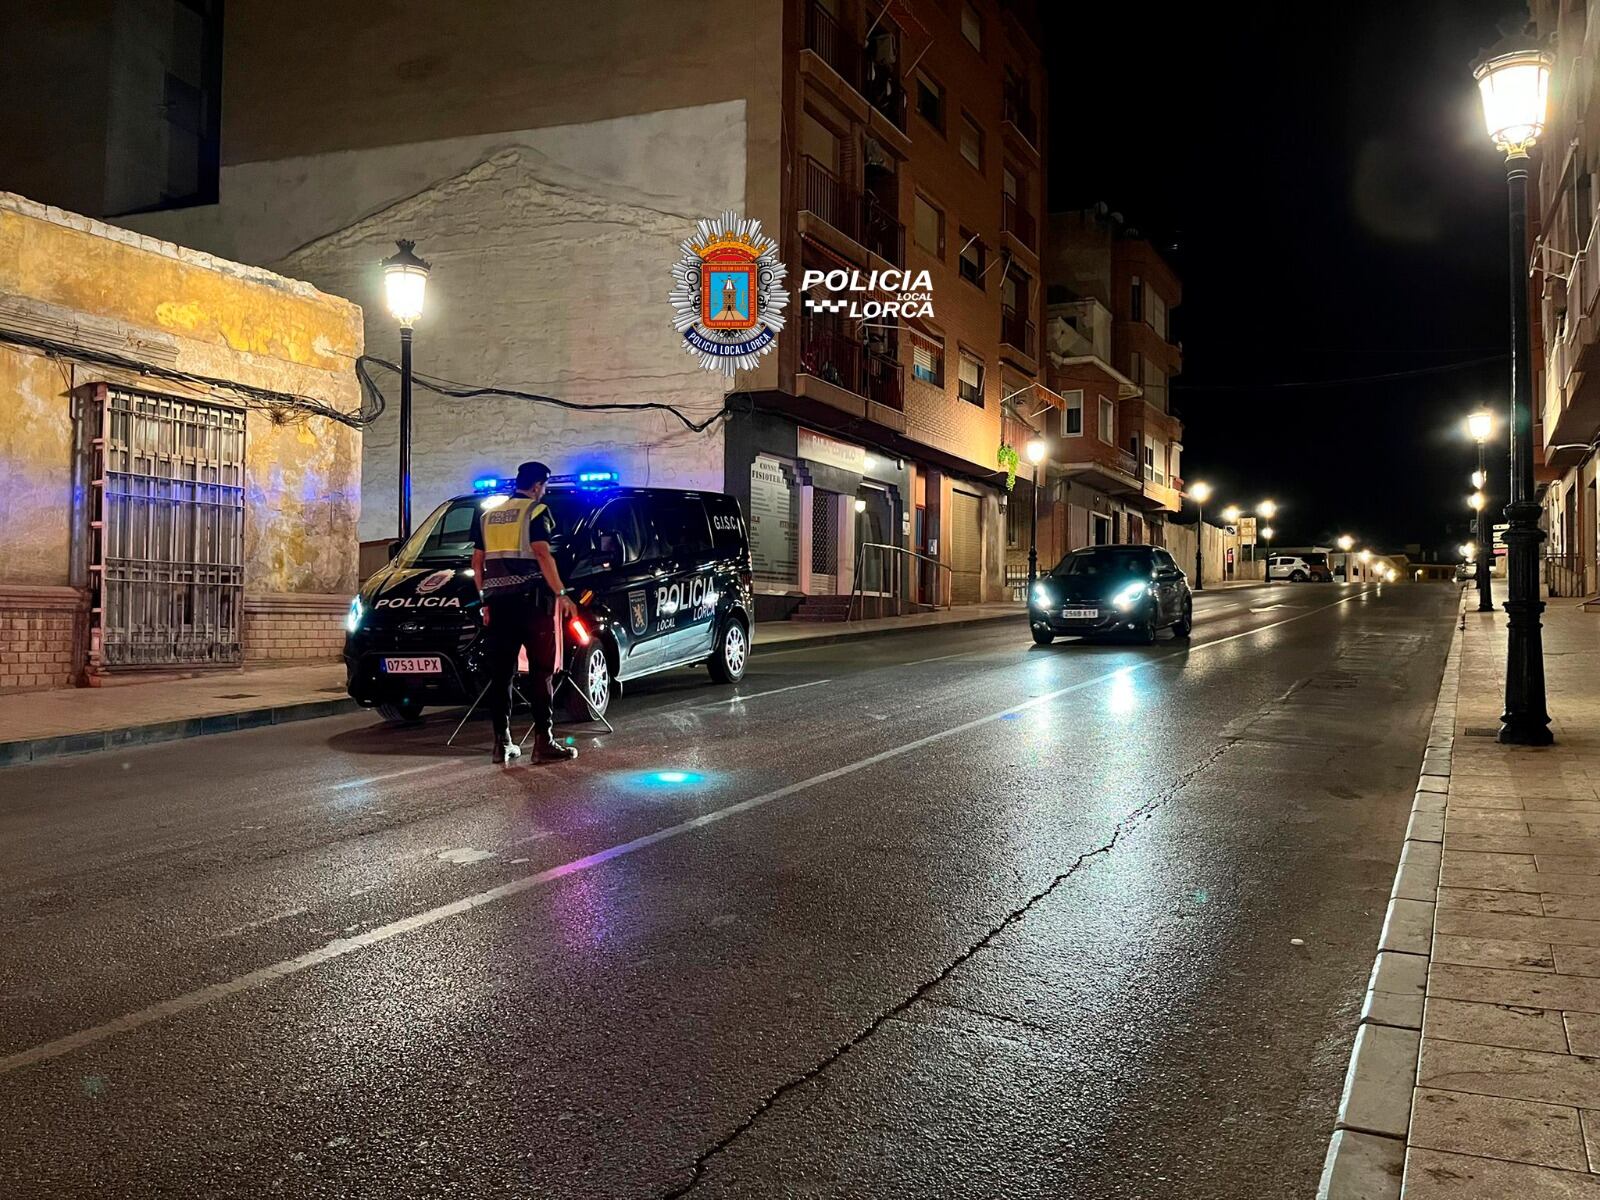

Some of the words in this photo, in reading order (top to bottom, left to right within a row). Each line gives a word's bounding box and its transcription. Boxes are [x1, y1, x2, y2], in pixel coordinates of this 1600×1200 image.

[374, 596, 461, 610] POLICIA
[656, 576, 716, 617] POLICIA
[656, 618, 676, 632] LOCAL
[693, 603, 716, 621] LORCA
[387, 659, 414, 671] 0753
[417, 659, 439, 671] LPX
